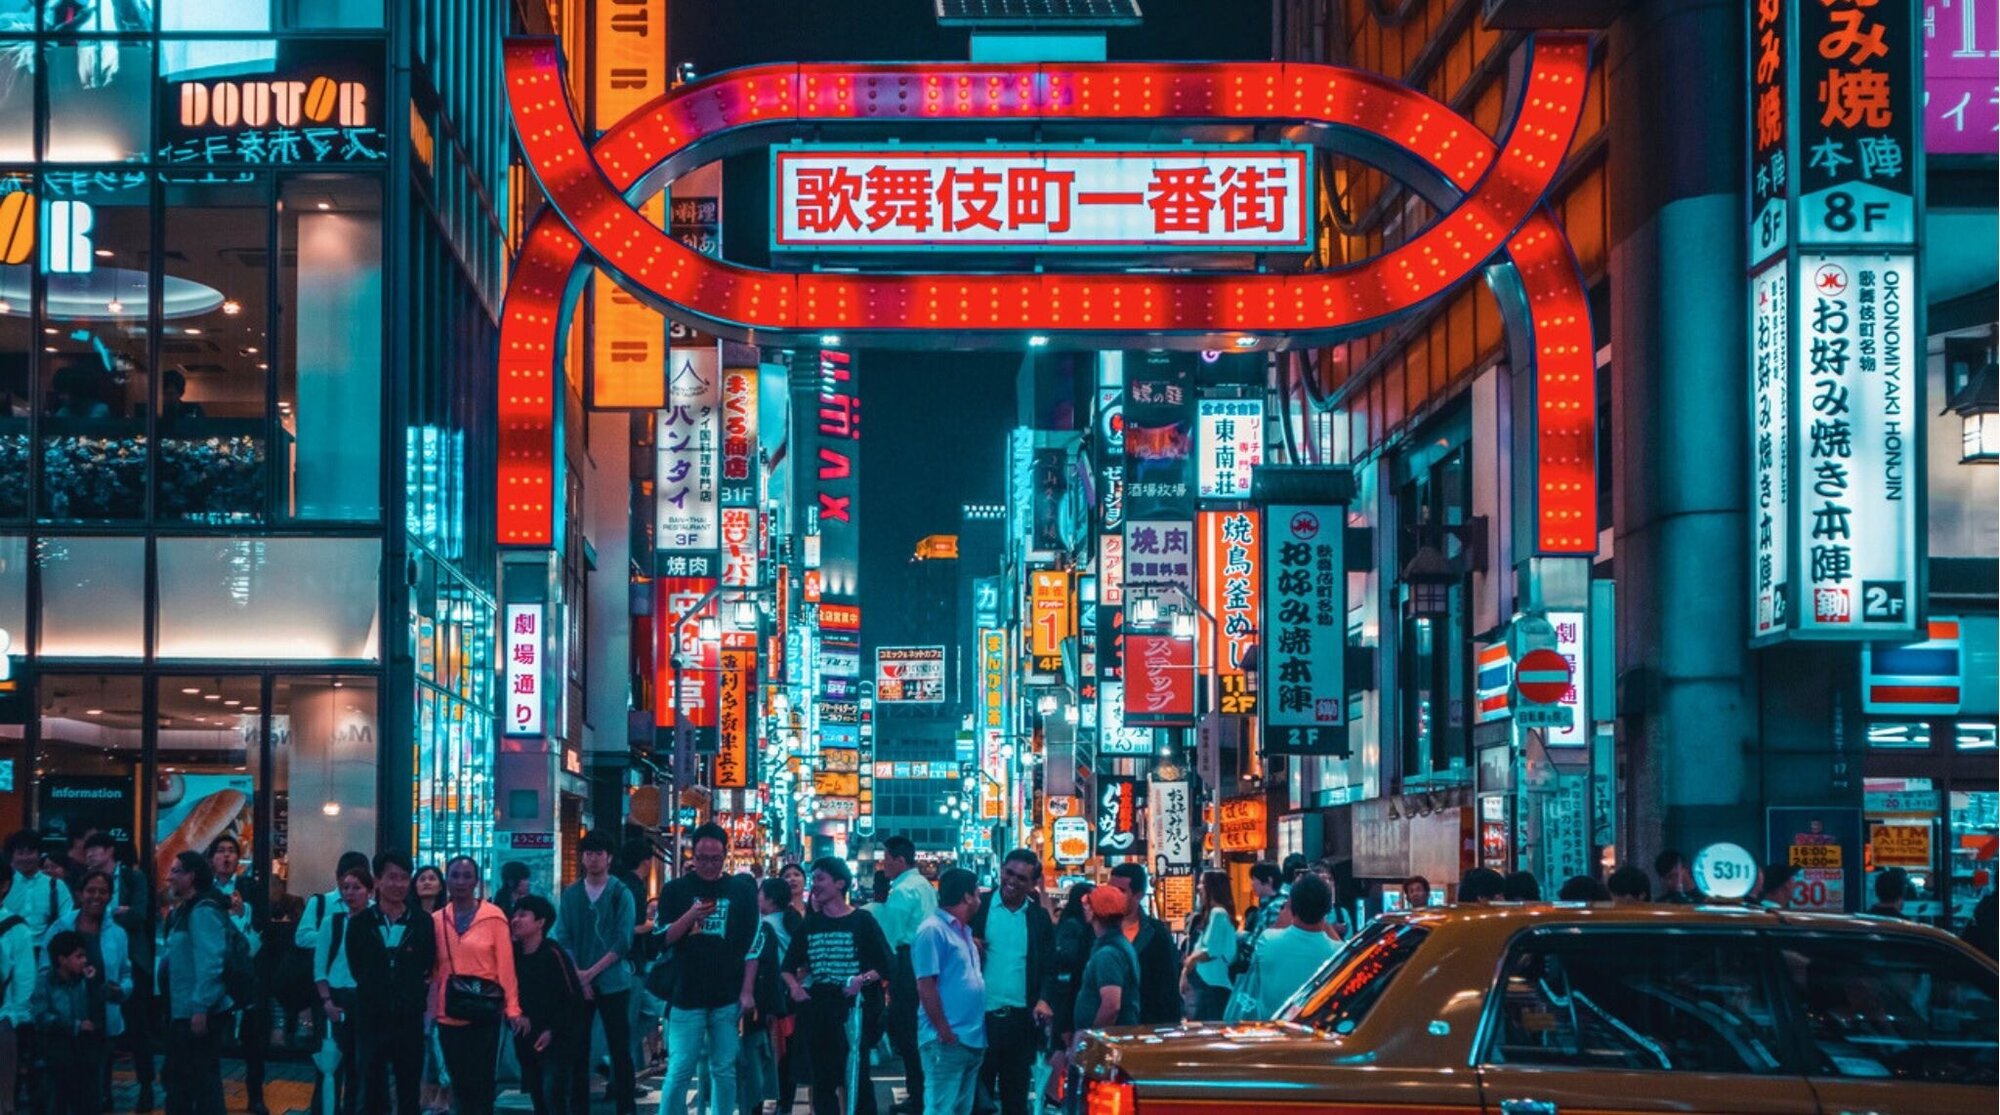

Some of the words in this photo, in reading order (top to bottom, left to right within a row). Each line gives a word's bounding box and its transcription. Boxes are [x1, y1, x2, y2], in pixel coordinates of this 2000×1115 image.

[1818, 0, 1893, 128] み焼
[180, 76, 368, 127] DOUTOR
[1810, 135, 1903, 179] 本陣
[796, 166, 1288, 233] 歌舞伎町一番街
[1823, 191, 1890, 233] 8F
[1761, 204, 1782, 249] 8F
[1858, 270, 1876, 373] 歌舞伎町名物
[1882, 270, 1901, 416] OKONOMIYAKI
[665, 404, 695, 510] バンタイ
[1215, 418, 1236, 496] 東南荘
[1757, 314, 1773, 592] お好み焼き本陣
[1810, 297, 1852, 585] お好み焼き本陣
[1883, 421, 1903, 501] HONJIN
[675, 532, 699, 546] 3F
[666, 556, 708, 577] 焼肉
[1221, 513, 1254, 671] 焼鳥釜めし
[1866, 586, 1904, 617] 2F
[724, 633, 747, 646] 4F
[1039, 613, 1058, 652] 1
[513, 613, 536, 724] 劇場通り
[1039, 657, 1063, 672] 4F
[1144, 638, 1175, 712] ステップ
[1221, 695, 1256, 713] 2F
[1287, 728, 1320, 746] 2F
[51, 786, 123, 799] information
[1713, 861, 1750, 879] 5311
